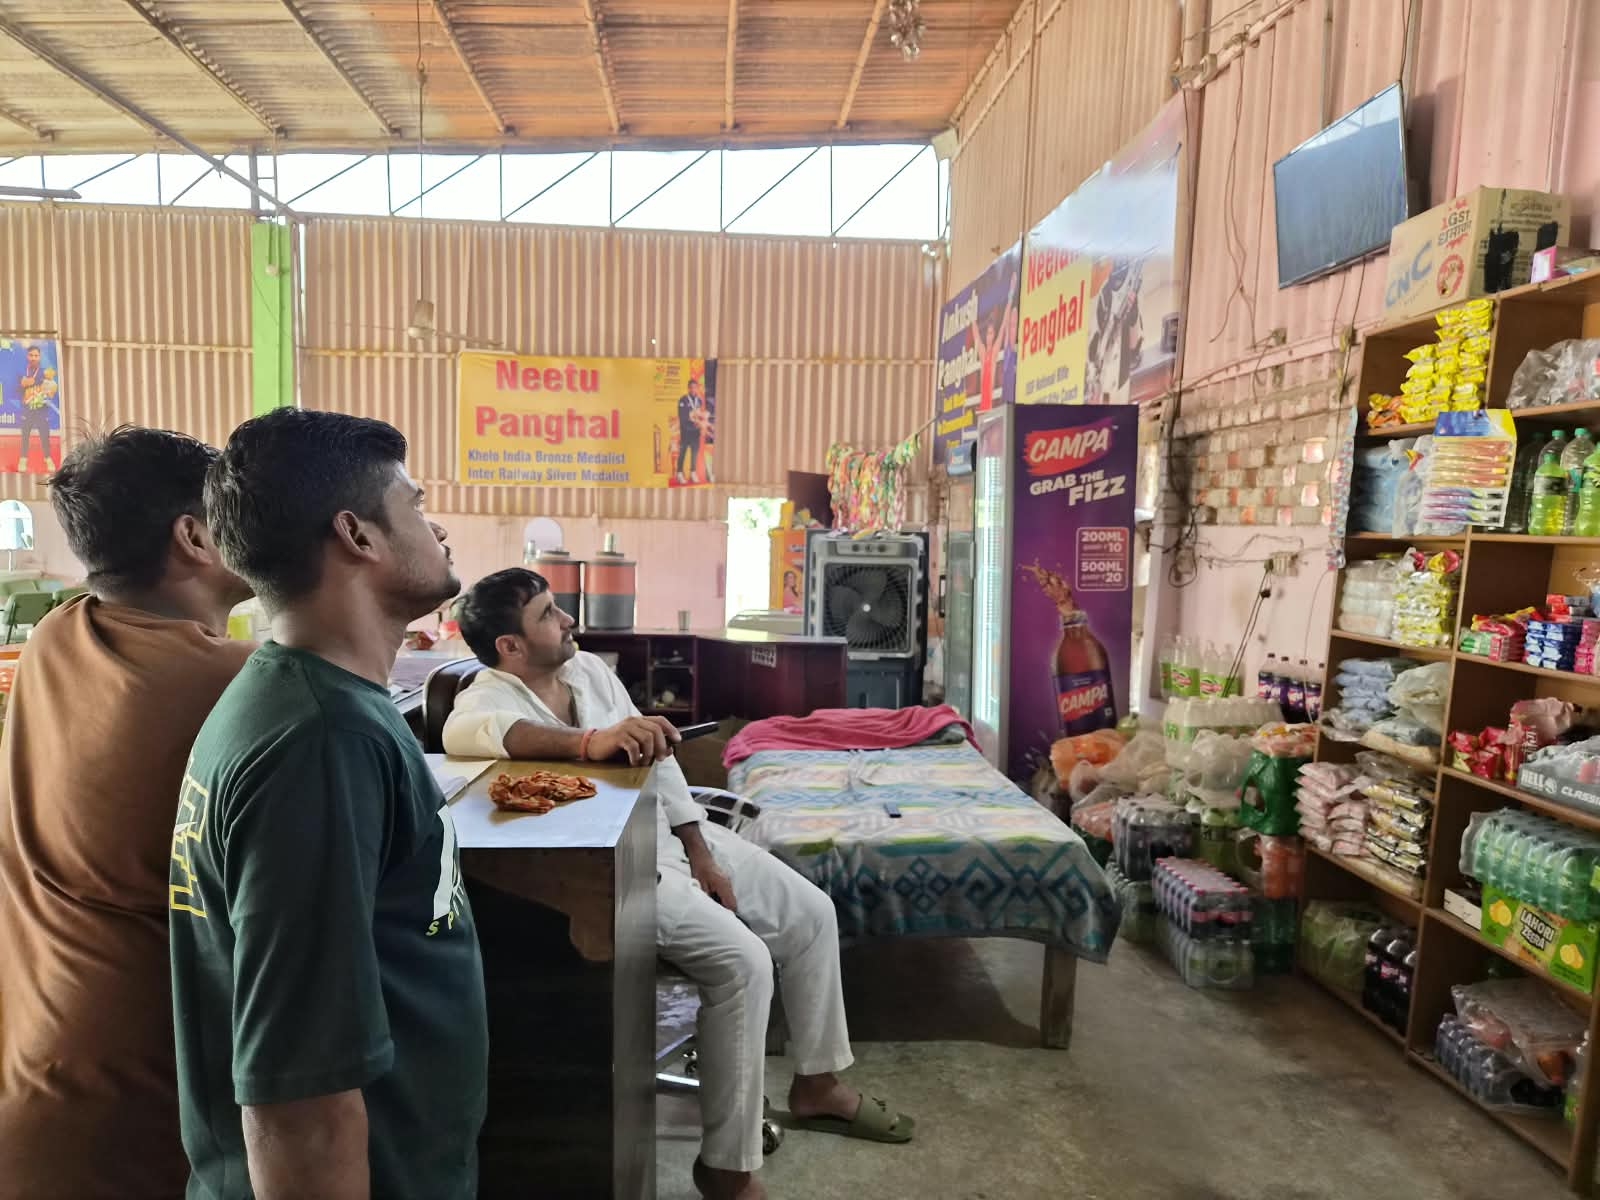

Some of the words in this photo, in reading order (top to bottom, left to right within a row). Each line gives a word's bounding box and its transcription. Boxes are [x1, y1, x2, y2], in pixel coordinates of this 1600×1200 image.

[1022, 280, 1085, 361] Panghal
[495, 359, 599, 393] Neetu
[475, 406, 620, 445] Panghal
[468, 450, 499, 462] Khelo
[503, 450, 531, 463] India
[535, 450, 573, 463] Bronze
[577, 451, 625, 465] Medalist
[1030, 427, 1110, 463] CAMPA
[468, 467, 495, 480] Inter
[499, 467, 542, 482] Railway
[546, 468, 577, 481] Silver
[581, 469, 630, 482] Medalist
[1030, 474, 1077, 496] GRAB
[1080, 469, 1105, 484] THE
[1068, 475, 1126, 506] FIZZ
[1081, 531, 1125, 542] 200ML
[1081, 561, 1125, 572] 500ML
[1060, 684, 1108, 713] CAMPA
[1521, 768, 1545, 788] HELL
[1521, 909, 1555, 942] LAHORI
[1521, 924, 1546, 951] ZEERA
